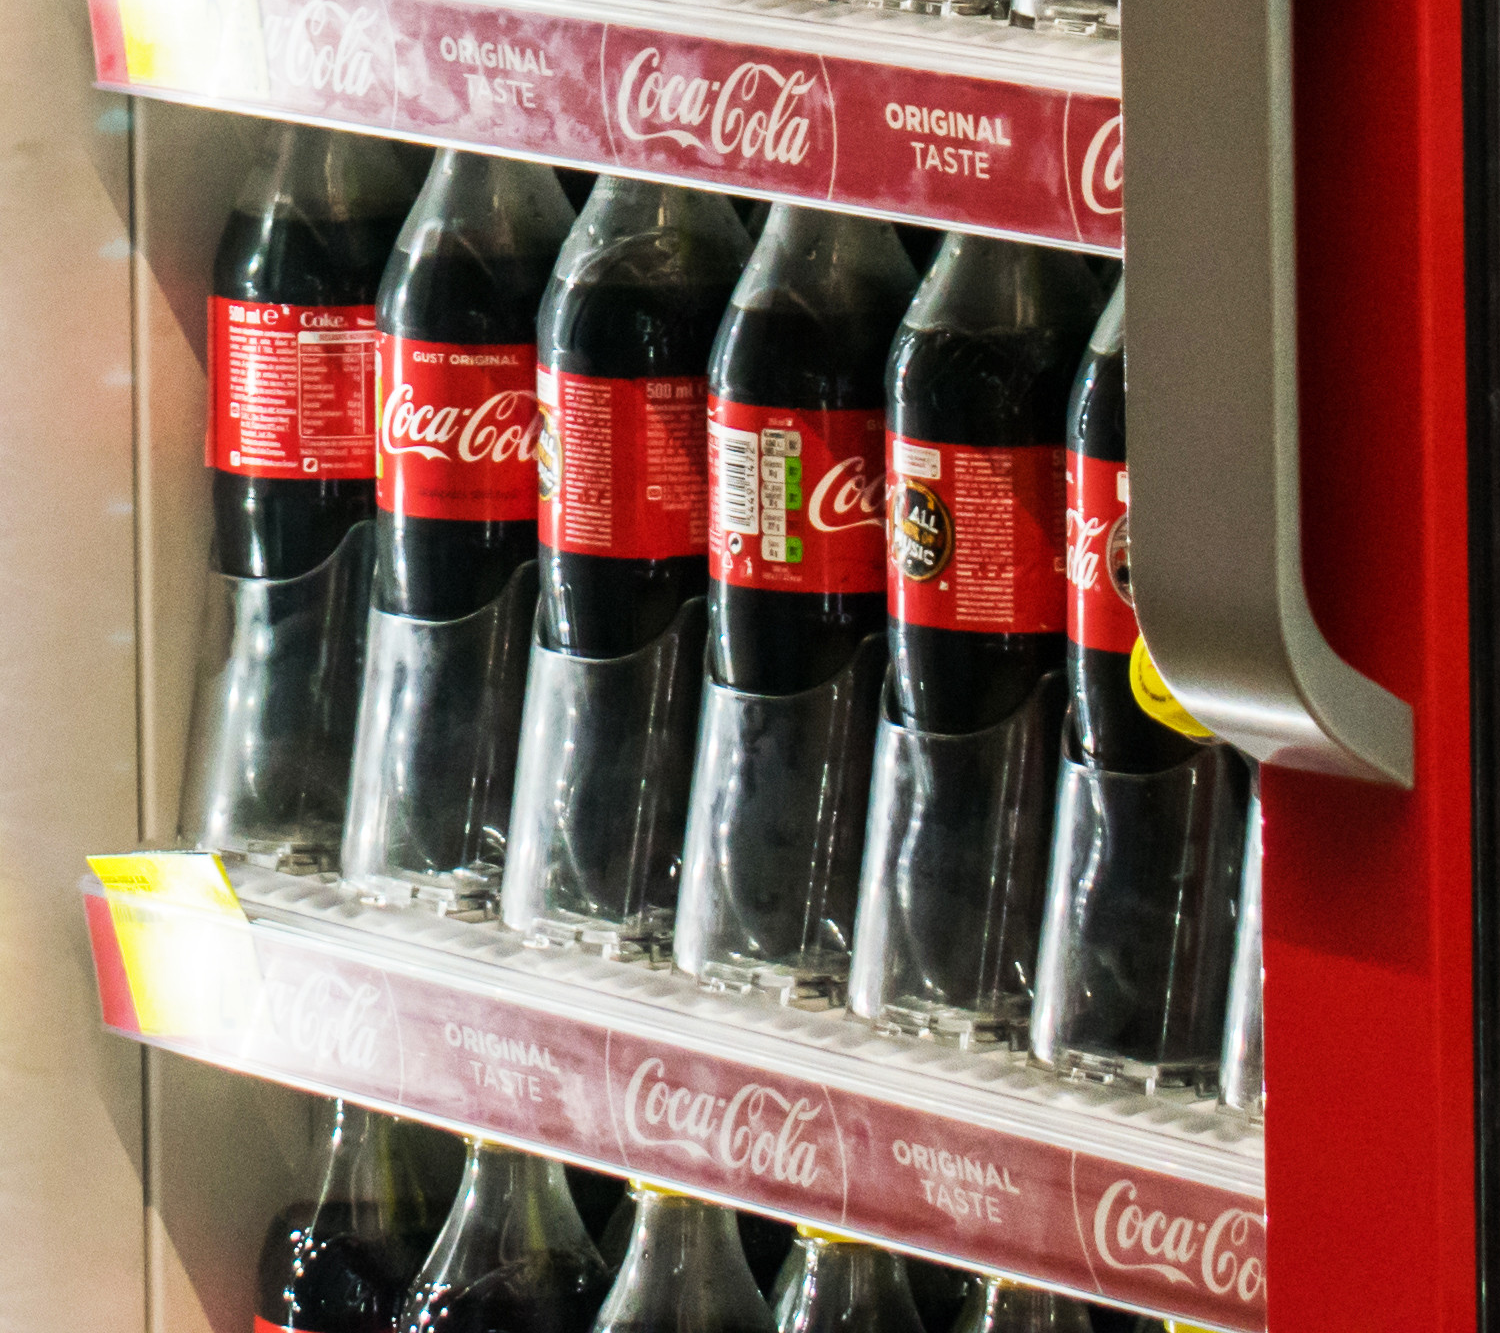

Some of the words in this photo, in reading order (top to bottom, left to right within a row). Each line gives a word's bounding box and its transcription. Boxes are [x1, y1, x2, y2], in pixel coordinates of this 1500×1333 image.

[439, 35, 555, 78] ORIGINAL
[463, 72, 536, 109] TASTE
[617, 46, 821, 167] Coca-Cola
[884, 101, 1012, 147] ORIGINAL
[910, 140, 991, 180] TASTE
[300, 310, 348, 329] Coke
[412, 351, 445, 364] GUST
[449, 352, 519, 366] ORIGINAL
[647, 383, 673, 399] 500
[675, 383, 694, 399] ml
[909, 505, 938, 534] ALL
[444, 1023, 561, 1075] ORIGINAL
[469, 1058, 543, 1103] TASTE
[624, 1057, 823, 1189] Coca-Cola
[892, 1138, 1021, 1196] ORIGINAL
[920, 1178, 1004, 1224] TASTE
[1094, 1179, 1267, 1303] Coca-Co
